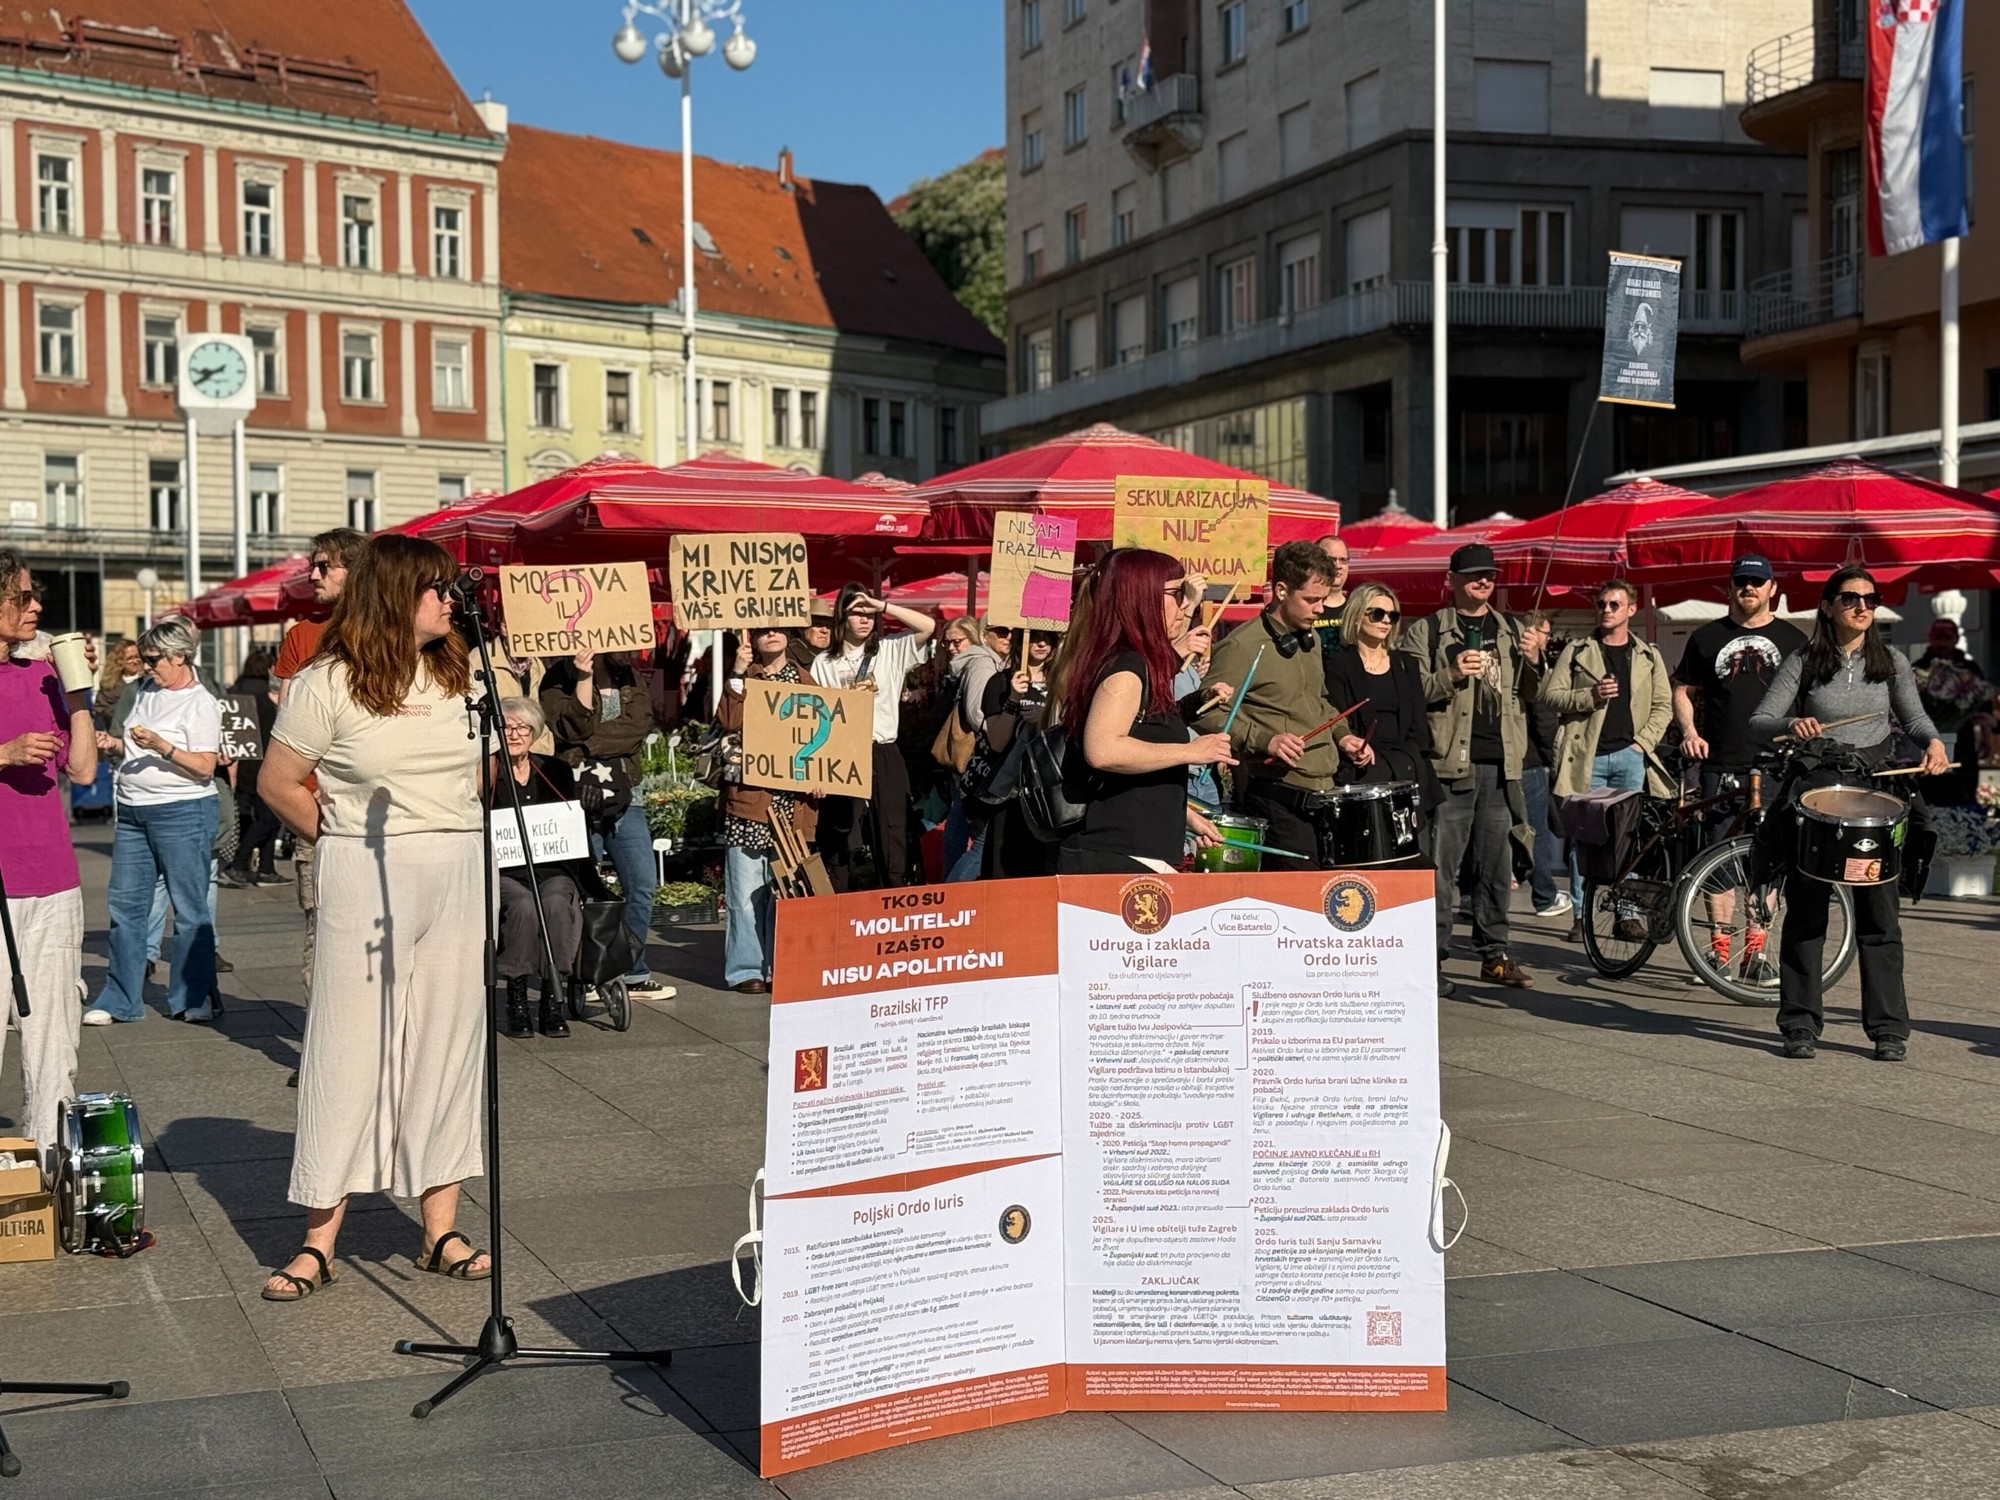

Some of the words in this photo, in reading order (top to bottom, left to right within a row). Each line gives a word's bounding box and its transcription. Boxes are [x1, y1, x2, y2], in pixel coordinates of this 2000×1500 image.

[1127, 490, 1258, 509] SEKULARIZACIJA
[1009, 520, 1060, 538] NISAM
[1163, 519, 1210, 543] NIJE
[683, 544, 709, 568] MI
[730, 541, 805, 565] NISMO
[510, 567, 627, 594] MOLITVA
[682, 569, 756, 599] KRIVE
[768, 567, 800, 591] ZA
[556, 599, 582, 619] ILI
[681, 597, 723, 621] VAŠE
[734, 597, 807, 618] GRIJEHE
[512, 624, 652, 652] PERFORMANS
[764, 691, 846, 724] VJERA
[792, 727, 814, 744] ILI
[745, 754, 862, 785] POLITIKA
[532, 819, 557, 837] KLEČI
[882, 894, 919, 910] TKO
[922, 892, 945, 905] SU
[1219, 923, 1236, 931] Vice
[877, 942, 882, 955] I
[885, 935, 945, 954] ZAŠTO
[1089, 939, 1143, 954] Udruga
[1147, 939, 1150, 950] i
[1155, 938, 1210, 950] zaklada
[1277, 936, 1343, 949] Hrvatska
[1347, 936, 1404, 948] zaklada
[1122, 956, 1178, 970] Vigilare
[1304, 953, 1341, 966] Ordo
[1345, 954, 1378, 965] Iuris
[822, 964, 872, 986] NISU
[876, 949, 1003, 980] APOLITIČNI
[1088, 983, 1109, 991] 2017.
[1116, 993, 1147, 1001] predana
[1148, 993, 1175, 1001] peticija
[1176, 993, 1198, 1001] protiv
[1200, 992, 1234, 1001] pobačaja
[1252, 991, 1287, 999] Službeno
[870, 998, 921, 1018] Brazilski
[925, 996, 948, 1011] TFP
[1088, 1024, 1116, 1032] Vigilare
[1151, 1023, 1192, 1031] Josipovića
[1345, 1037, 1384, 1045] parlament
[1088, 1067, 1116, 1075] Vigilare
[1118, 1067, 1153, 1075] podržava
[1184, 1066, 1229, 1074] Istanbulskoj
[1253, 1087, 1284, 1095] pobačaj
[1089, 1112, 1113, 1120] 2020.
[1120, 1112, 1143, 1120] 2025.
[1090, 1121, 1113, 1129] Tužbe
[1129, 1121, 1181, 1130] diskriminaciju
[1186, 1121, 1209, 1130] protiv
[1089, 1131, 1125, 1139] zajednice
[1123, 1140, 1147, 1148] Peticija
[1252, 1150, 1289, 1158] POČINJE
[1319, 1149, 1361, 1158] KLEČANJE
[1369, 1150, 1380, 1158] RH
[853, 1204, 894, 1225] Poljski
[898, 1199, 930, 1216] Ordo
[934, 1194, 964, 1210] Iuris
[1093, 1225, 1124, 1234] Vigilare
[1157, 1225, 1186, 1233] obitelji
[1208, 1225, 1237, 1233] Zagreb
[1316, 1238, 1340, 1246] Sanju
[1141, 1276, 1200, 1285] ZAKLJUČAK
